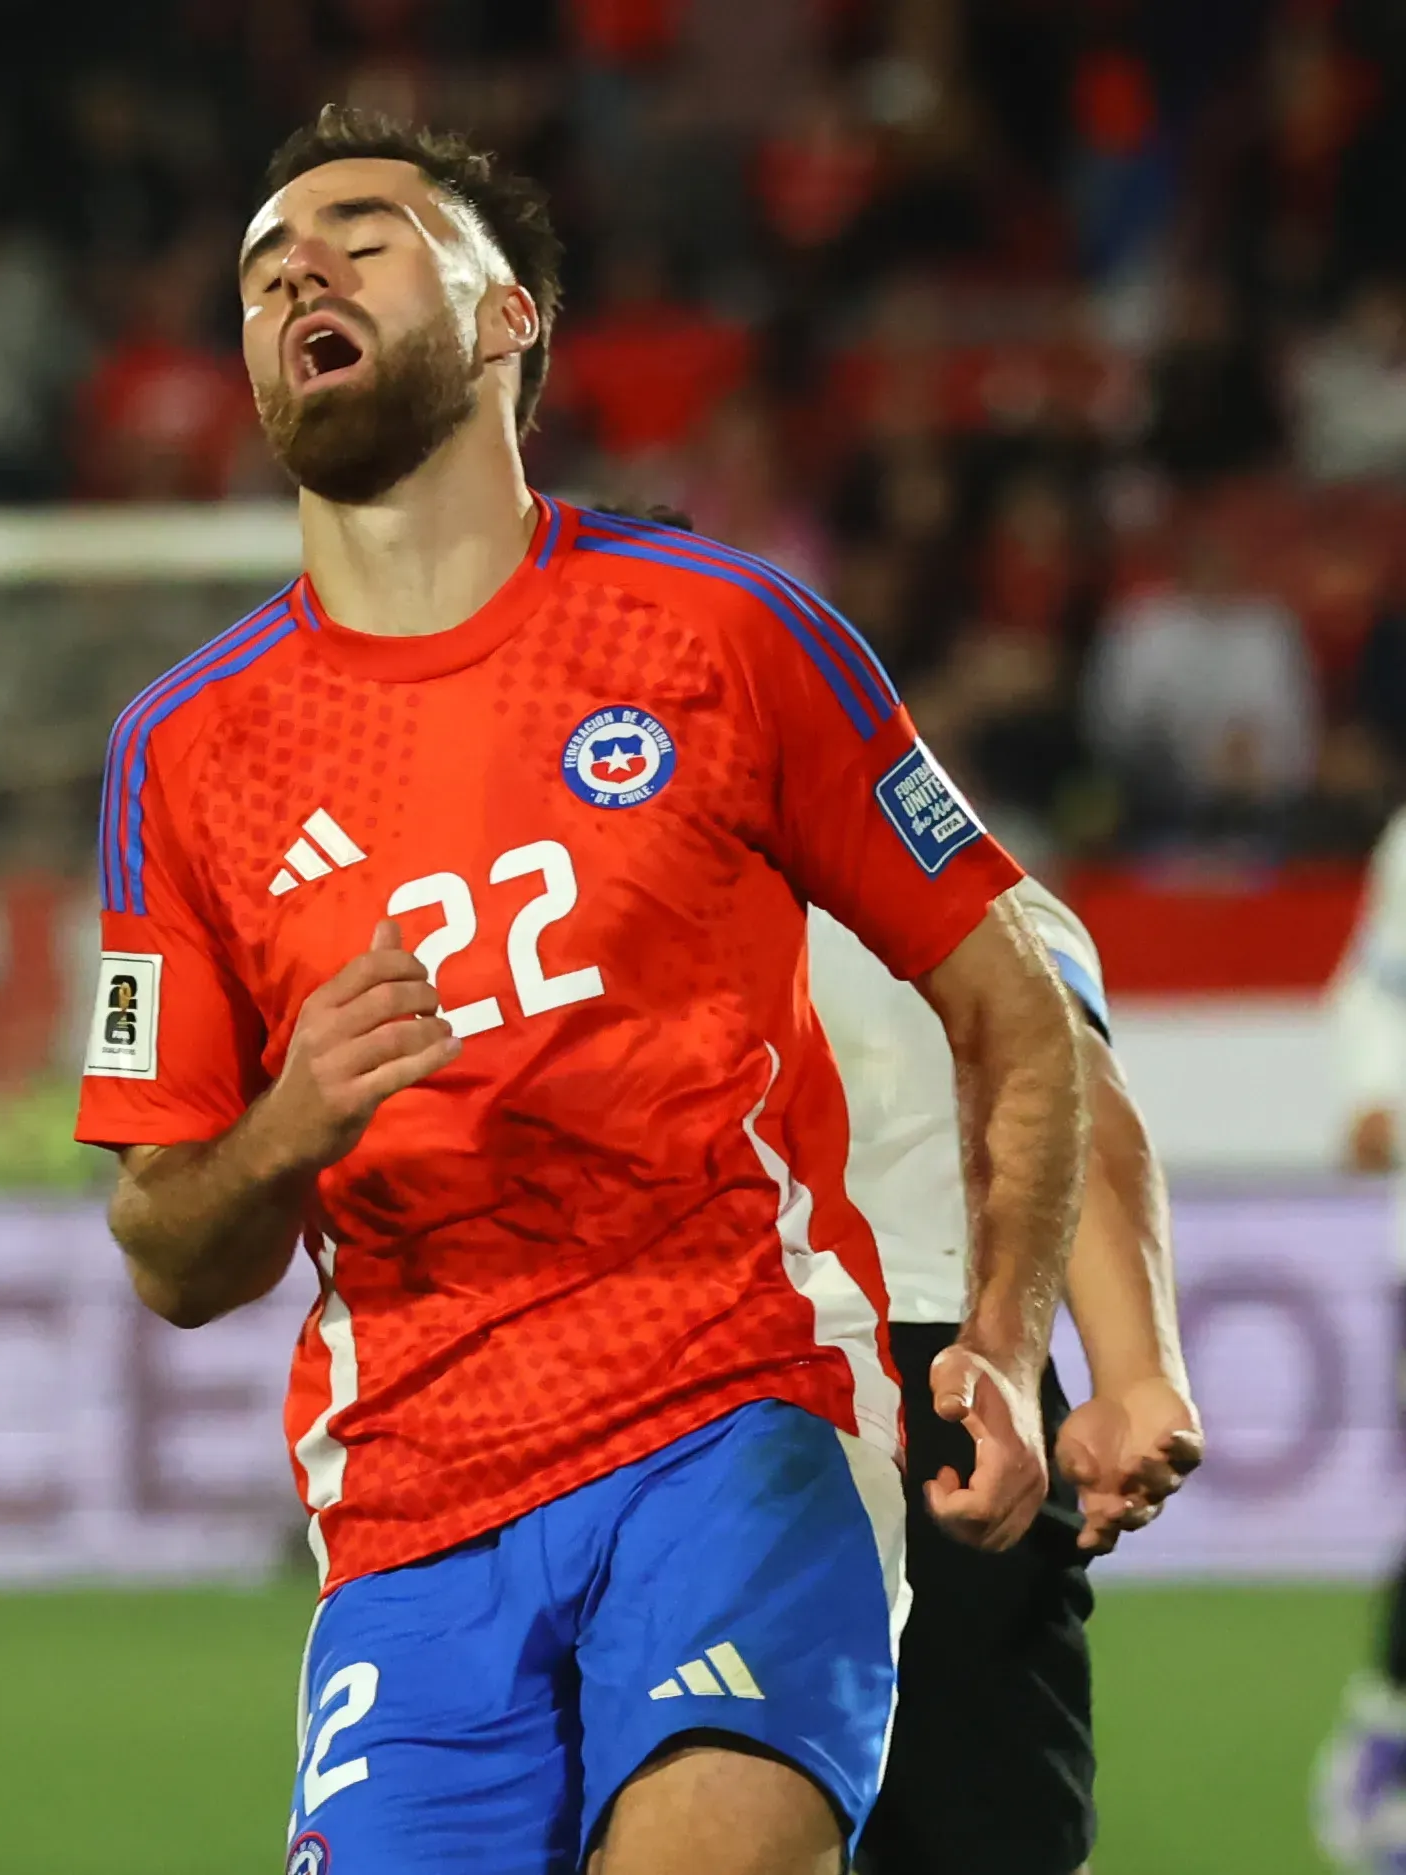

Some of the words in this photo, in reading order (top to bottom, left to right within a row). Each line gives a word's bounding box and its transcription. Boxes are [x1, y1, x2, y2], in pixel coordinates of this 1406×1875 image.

[564, 711, 614, 768] FEDERACION
[622, 711, 640, 724] DE
[594, 792, 612, 805] DE
[618, 786, 652, 804] CHILE
[894, 762, 933, 799] FOOTBA
[902, 775, 945, 817] UNITE
[937, 819, 961, 837] FIFA
[387, 839, 606, 1040] 22
[296, 1661, 380, 1822] 2
